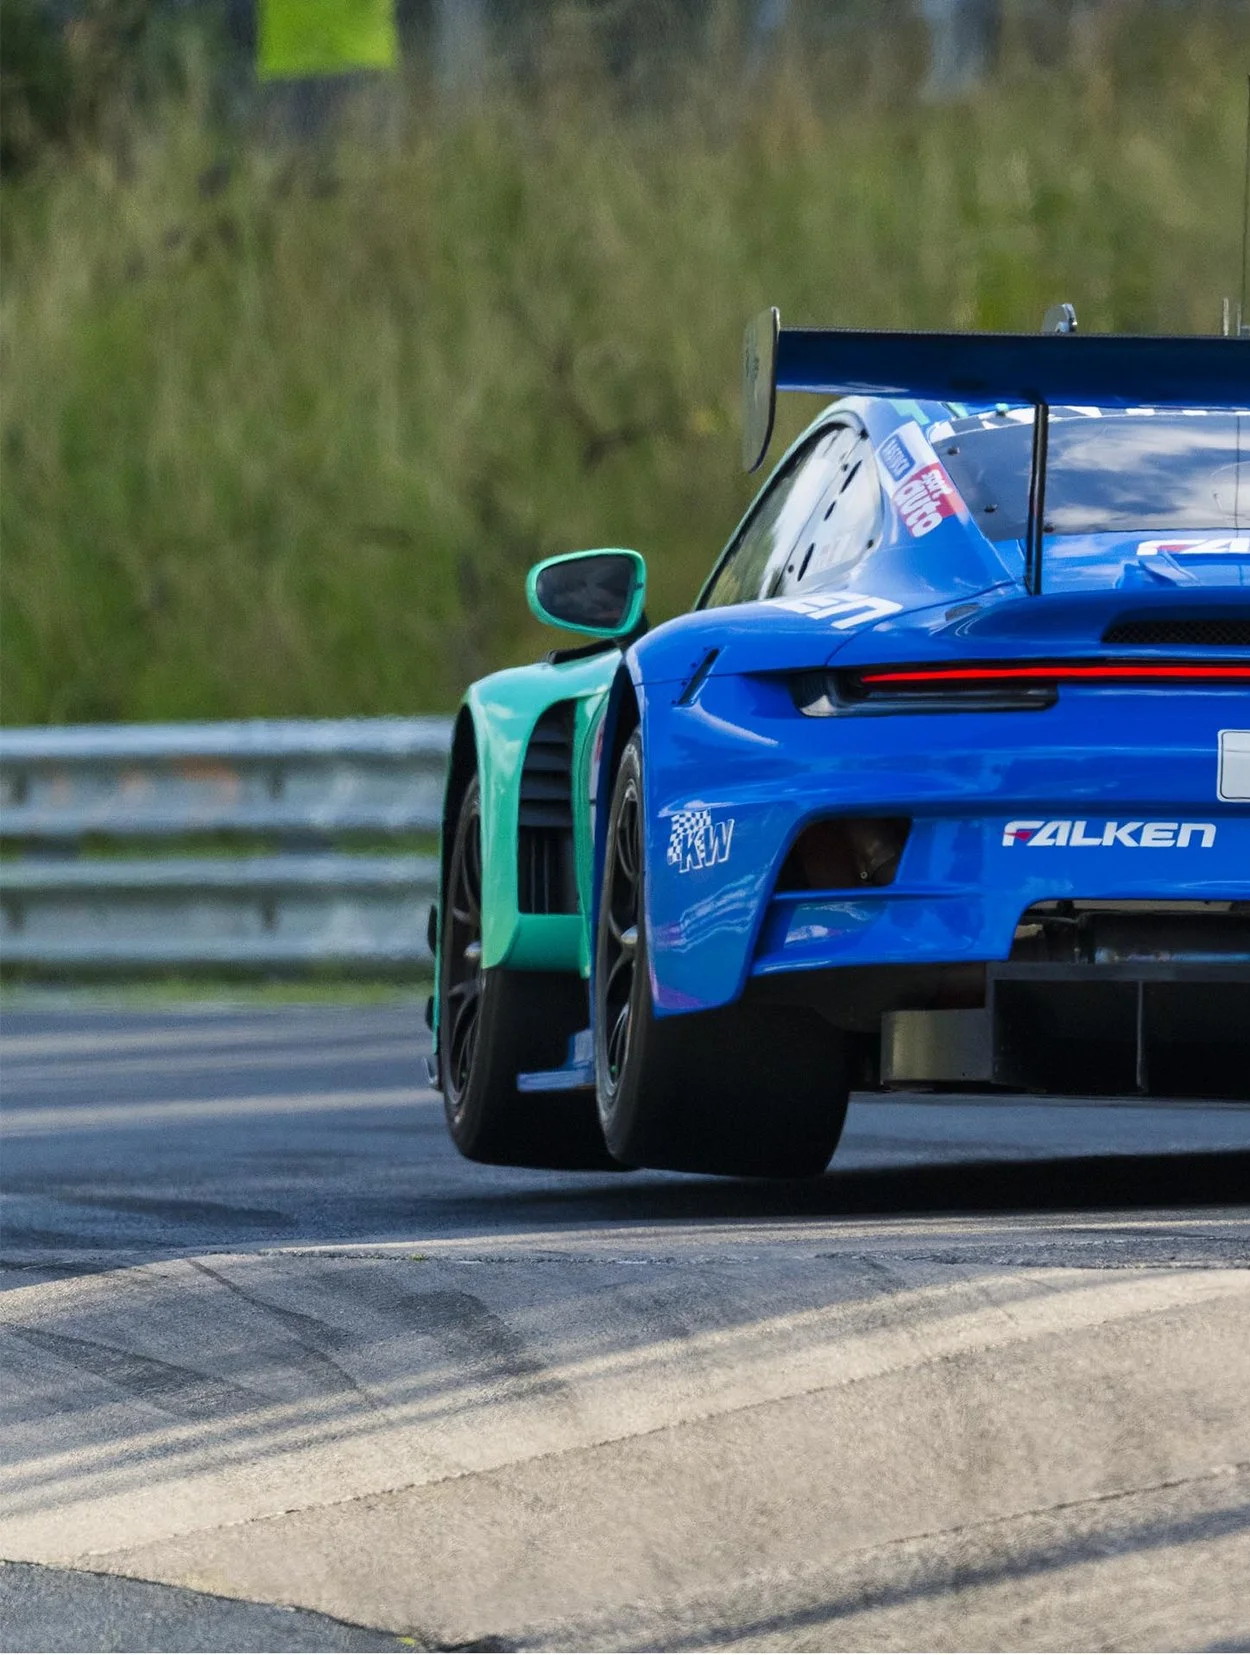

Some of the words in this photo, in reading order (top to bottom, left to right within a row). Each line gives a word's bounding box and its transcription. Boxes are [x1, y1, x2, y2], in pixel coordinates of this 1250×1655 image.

[893, 479, 943, 538] auto
[679, 818, 735, 873] KW
[1002, 820, 1217, 848] FALKEN
